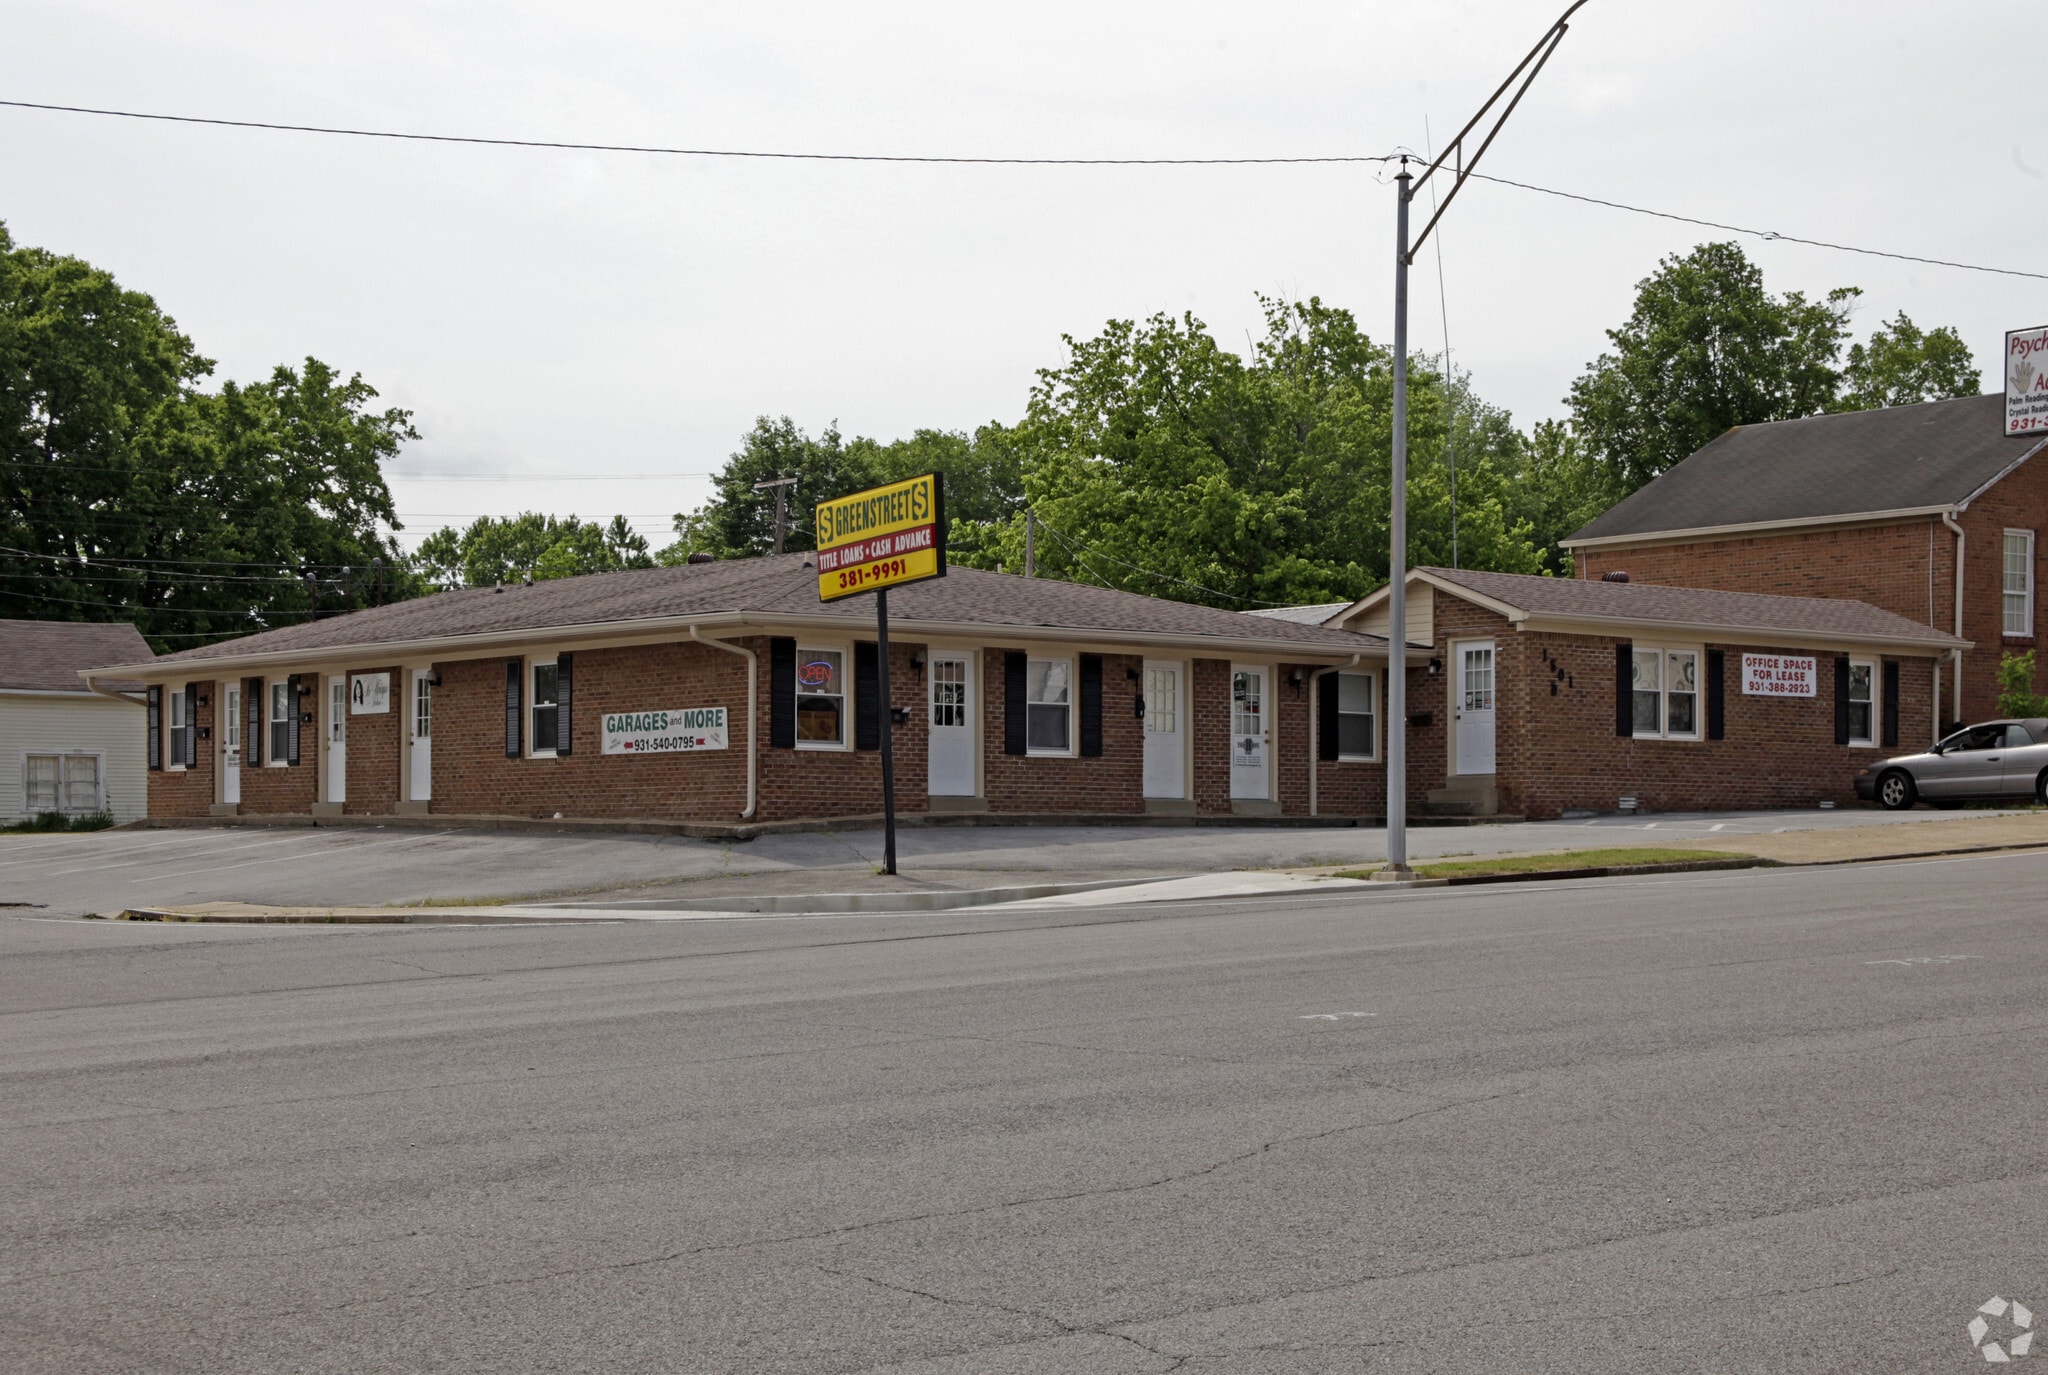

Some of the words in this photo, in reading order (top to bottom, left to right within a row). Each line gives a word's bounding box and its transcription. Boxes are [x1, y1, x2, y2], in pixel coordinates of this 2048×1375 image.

[2009, 397, 2023, 405] Palm
[2009, 406, 2029, 417] Crystal
[836, 489, 910, 536] GREENSTREET
[819, 552, 838, 570] TITLE
[841, 544, 864, 565] LOANS
[871, 538, 891, 557] CASH
[895, 529, 931, 552] ADVANCE
[839, 559, 906, 589] 381-9991
[1745, 657, 1779, 668] OFFICE
[1783, 659, 1812, 670] SPACE
[799, 665, 832, 681] OPEN
[1753, 669, 1772, 680] FOR
[1776, 671, 1805, 681] LEASE
[607, 712, 668, 733] GARAGES
[670, 716, 682, 725] and
[684, 709, 723, 729] MORE
[634, 736, 694, 751] 931-540-0795
